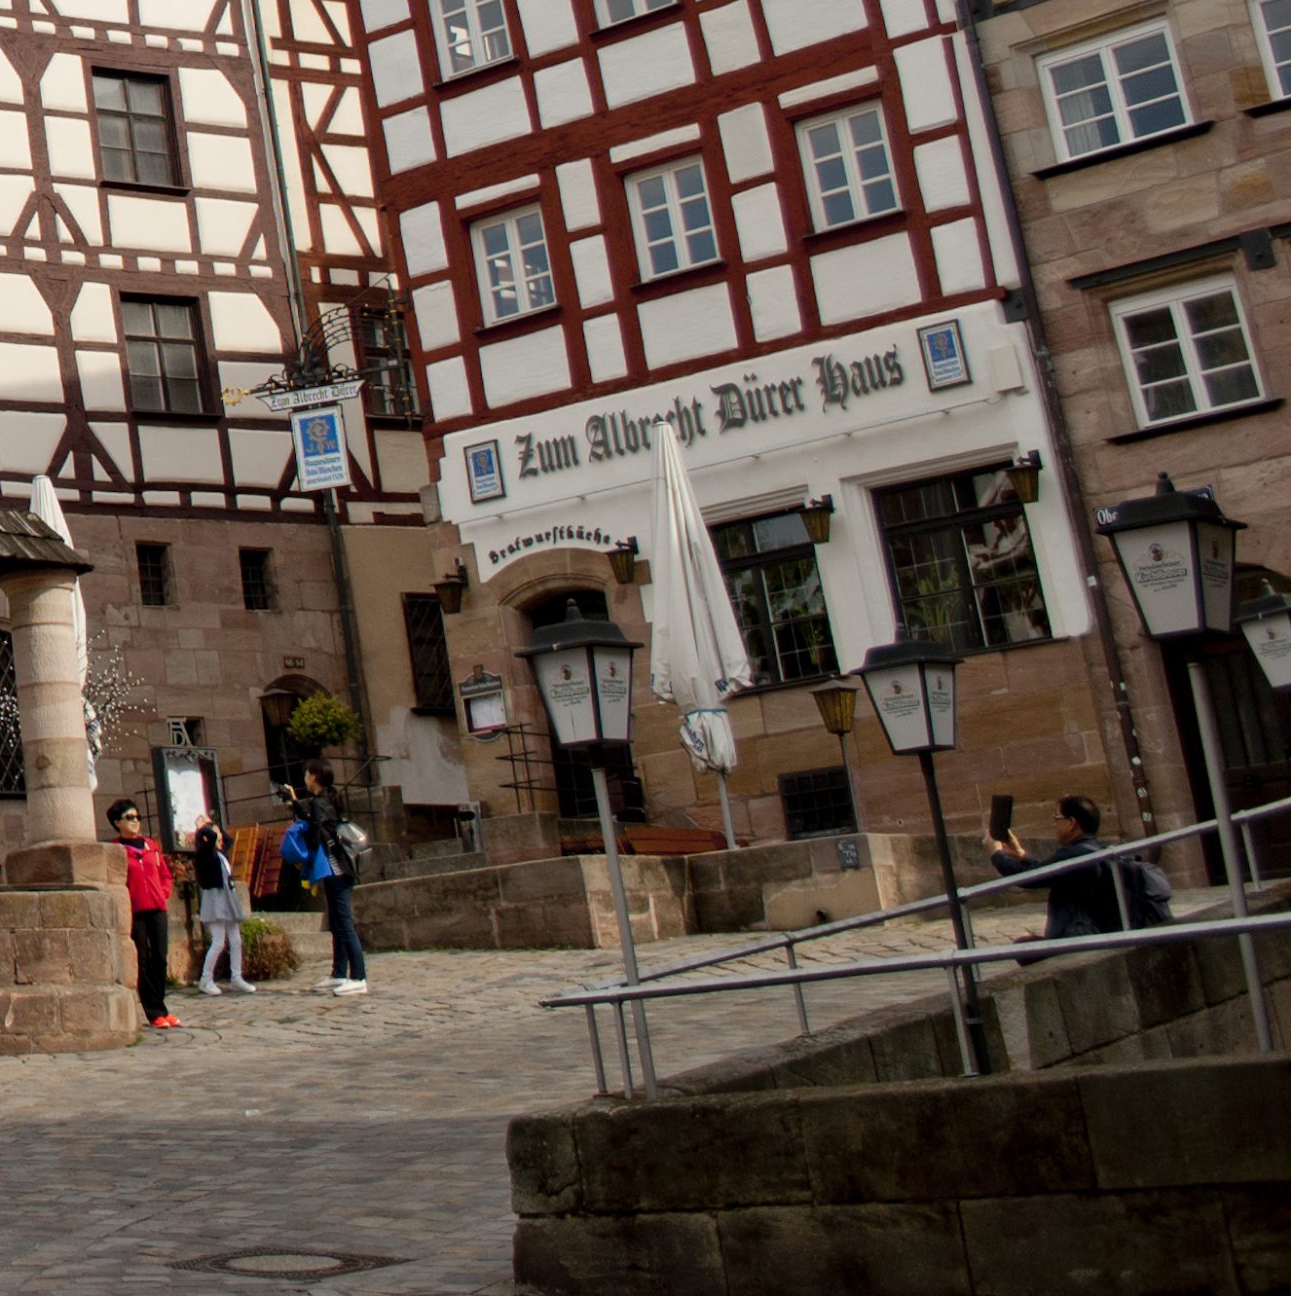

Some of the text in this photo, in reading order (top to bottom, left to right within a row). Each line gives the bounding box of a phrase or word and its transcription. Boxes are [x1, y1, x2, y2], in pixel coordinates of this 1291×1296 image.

[271, 384, 358, 408] Zum Albrecht Dürer
[514, 342, 905, 479] Zum Albrht Dürer Haus
